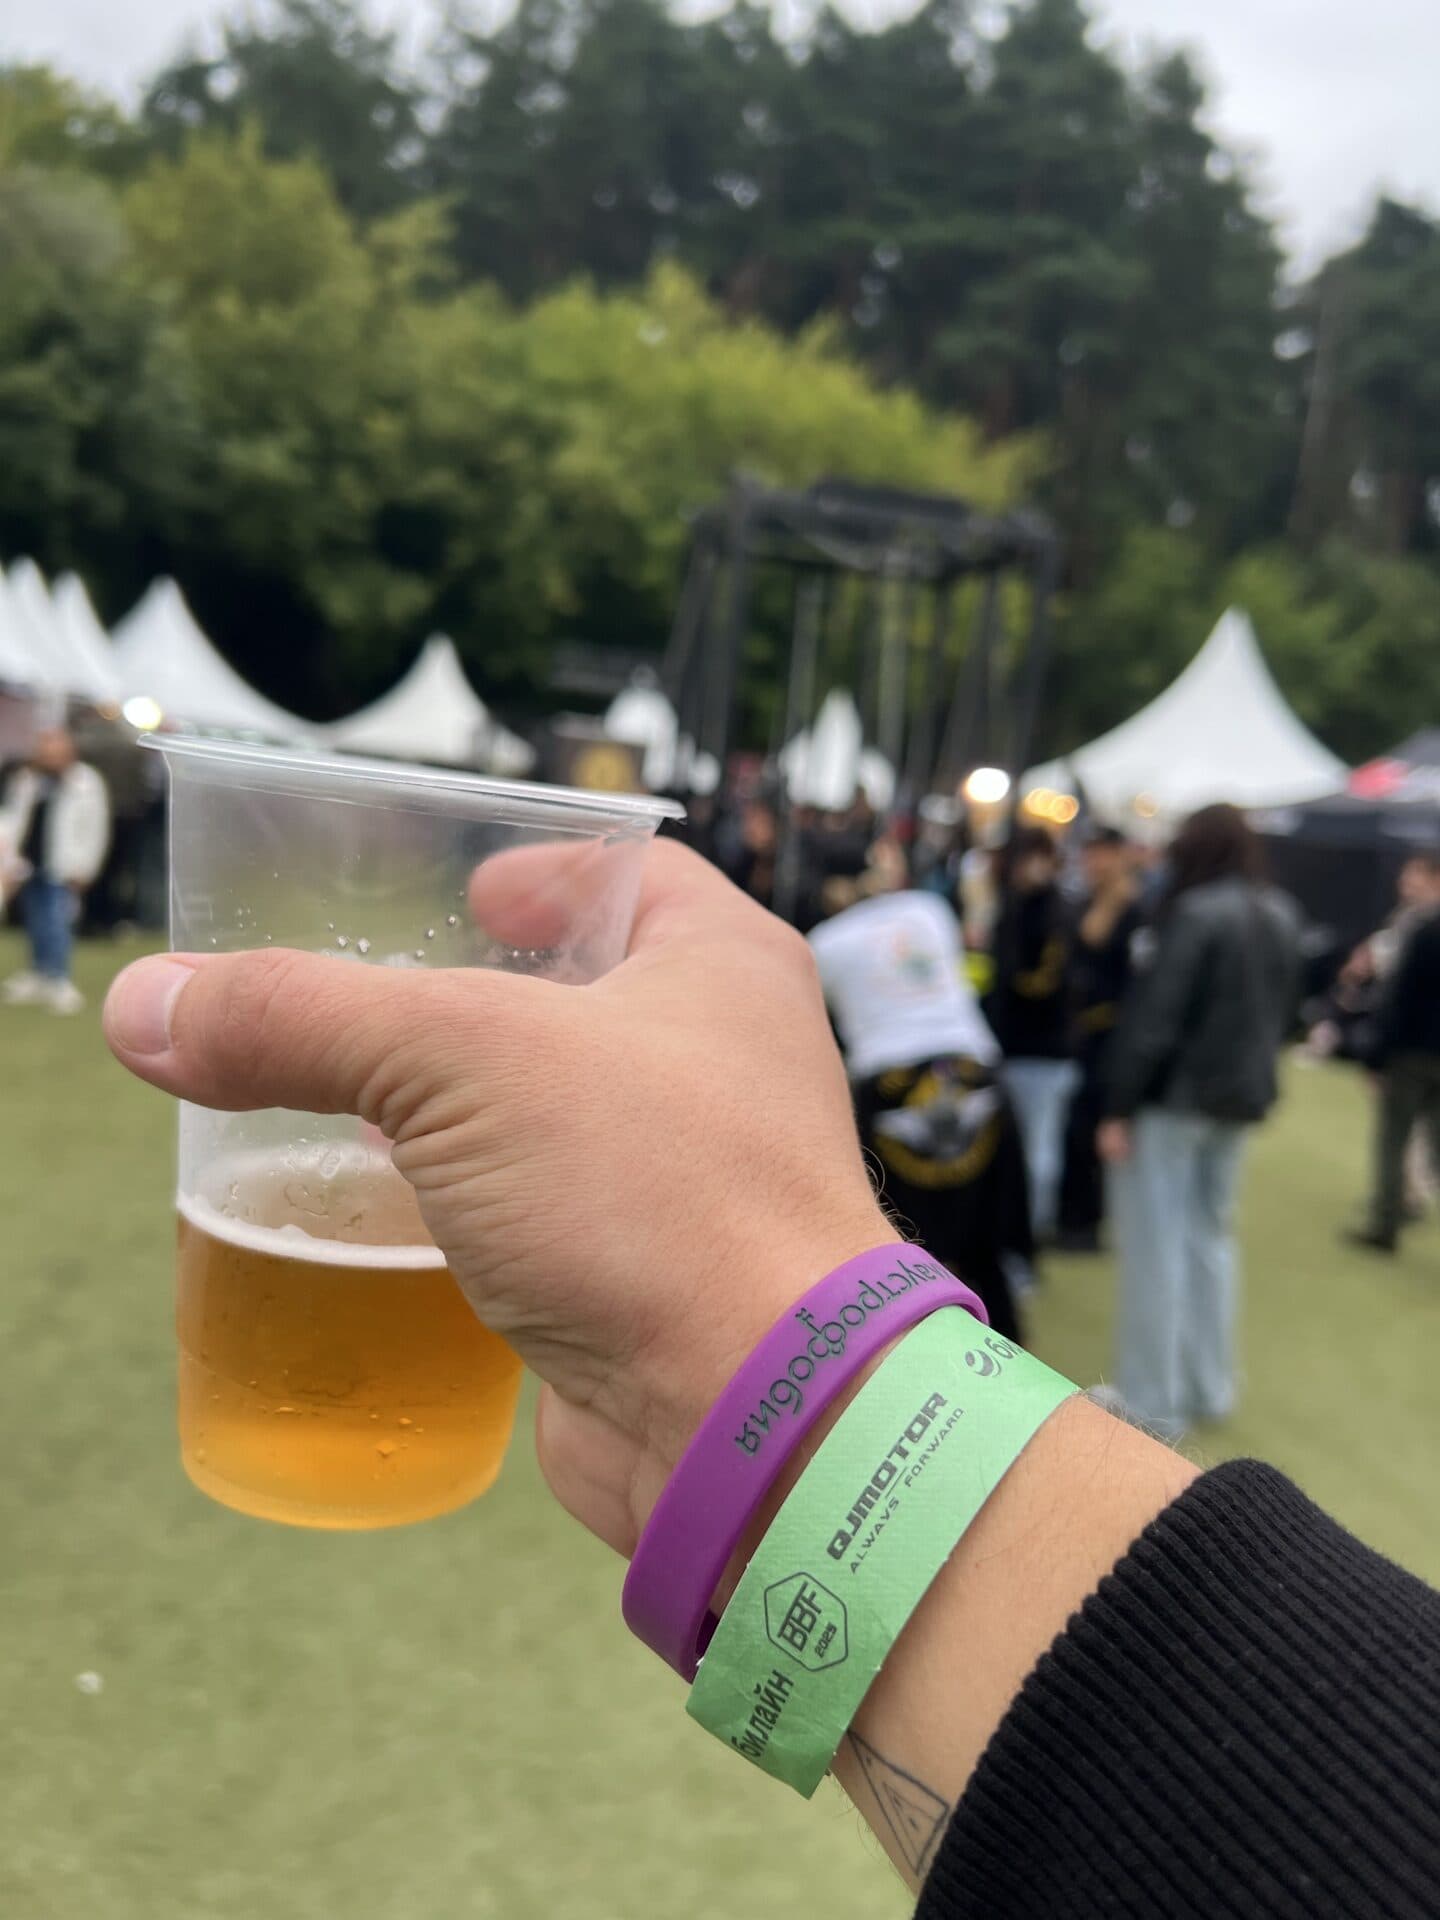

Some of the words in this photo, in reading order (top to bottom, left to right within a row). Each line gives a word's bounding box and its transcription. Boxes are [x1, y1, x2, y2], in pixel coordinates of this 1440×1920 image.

[826, 1391, 949, 1561] QJMOTOR
[849, 1496, 900, 1574] ALWAYS
[904, 1407, 965, 1488] FORWARD
[776, 1580, 823, 1653] BBF
[814, 1621, 838, 1659] 2025
[730, 1668, 795, 1758] билайн
